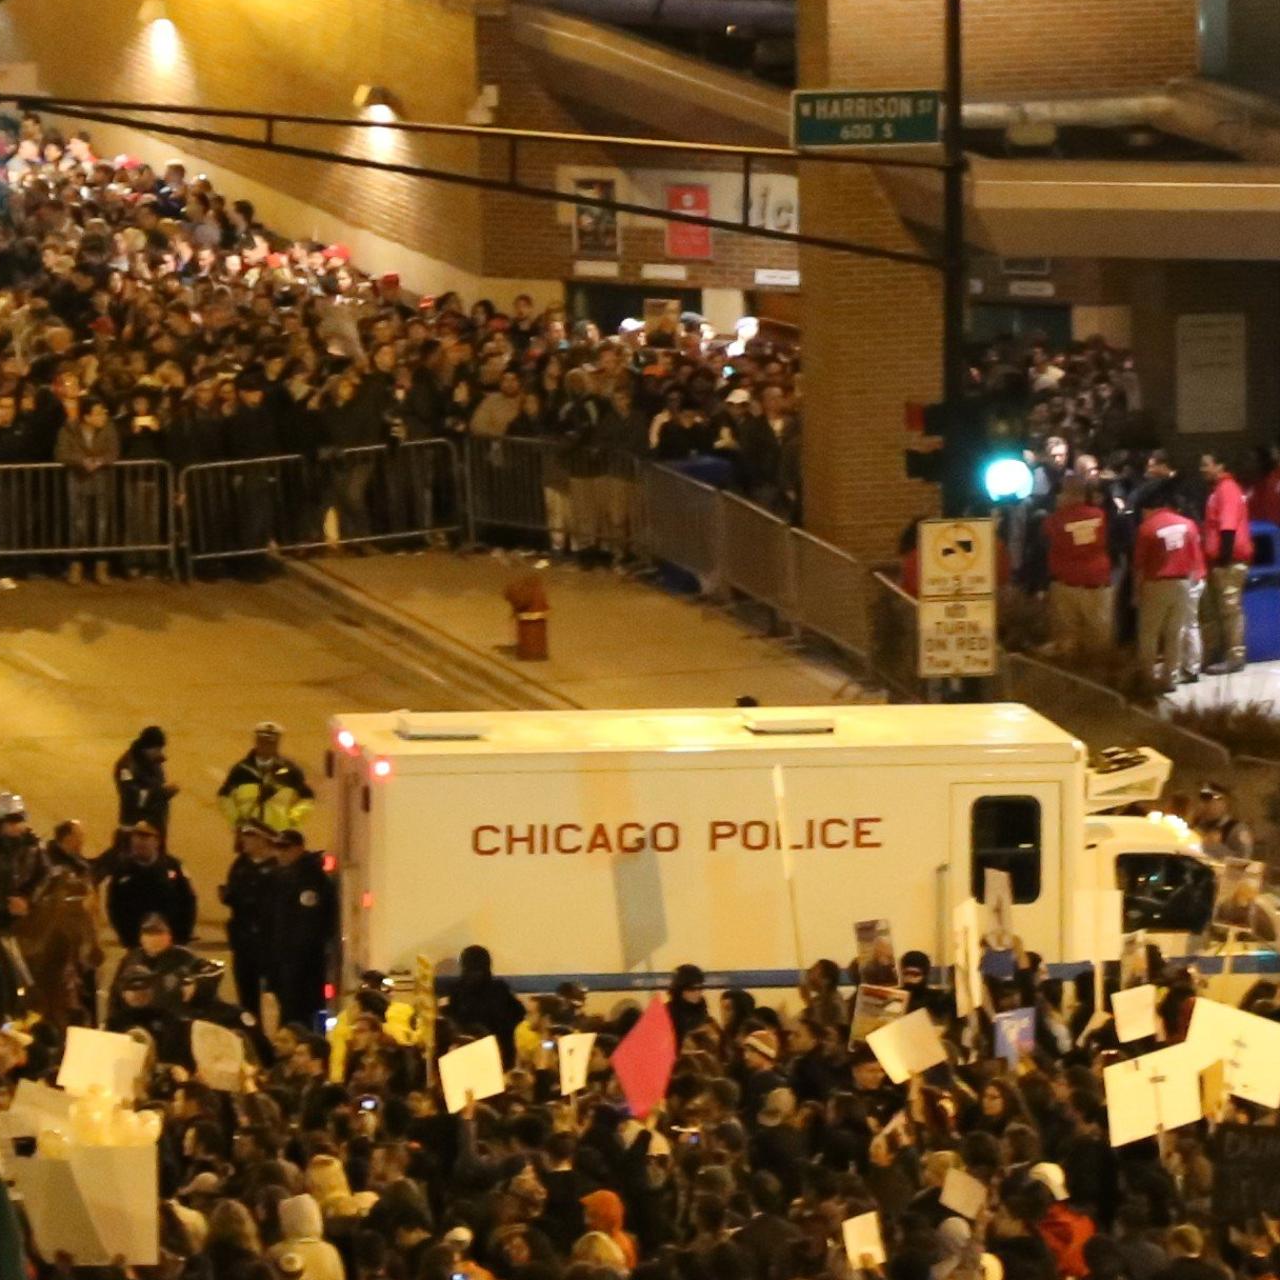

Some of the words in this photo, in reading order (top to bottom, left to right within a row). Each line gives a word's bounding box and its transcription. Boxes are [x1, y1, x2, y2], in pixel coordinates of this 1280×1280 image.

[815, 96, 913, 120] HARRISON
[839, 124, 874, 140] 600
[955, 636, 989, 651] RED
[472, 821, 680, 857] CHICAGO
[708, 818, 885, 852] POLICE
